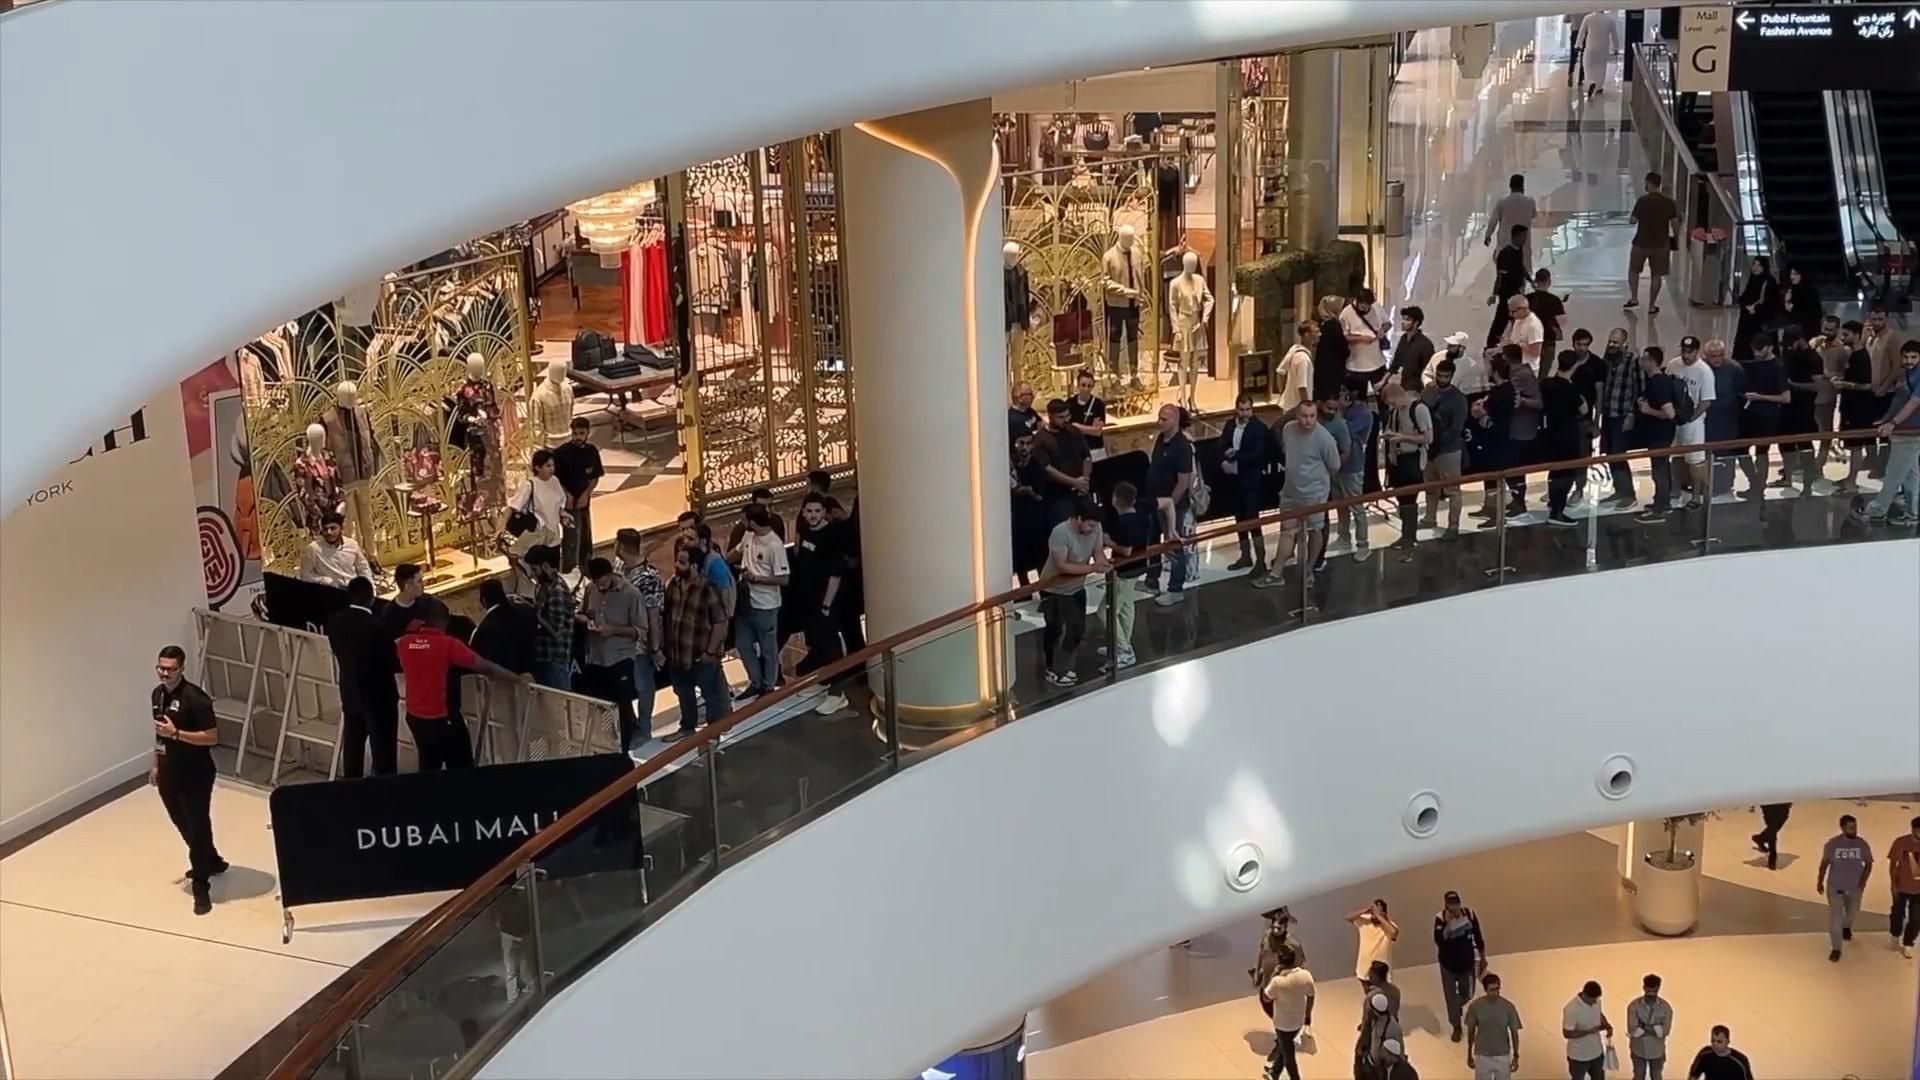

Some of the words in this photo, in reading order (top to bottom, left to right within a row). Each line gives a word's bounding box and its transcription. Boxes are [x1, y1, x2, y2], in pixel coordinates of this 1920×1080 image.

[1696, 11, 1718, 20] Mall
[1760, 13, 1789, 24] Dubai
[1790, 13, 1831, 23] Fountain
[1760, 26, 1796, 36] Fashion
[1796, 26, 1833, 36] Avenue
[1692, 45, 1718, 74] G
[356, 822, 461, 850] DUBAI
